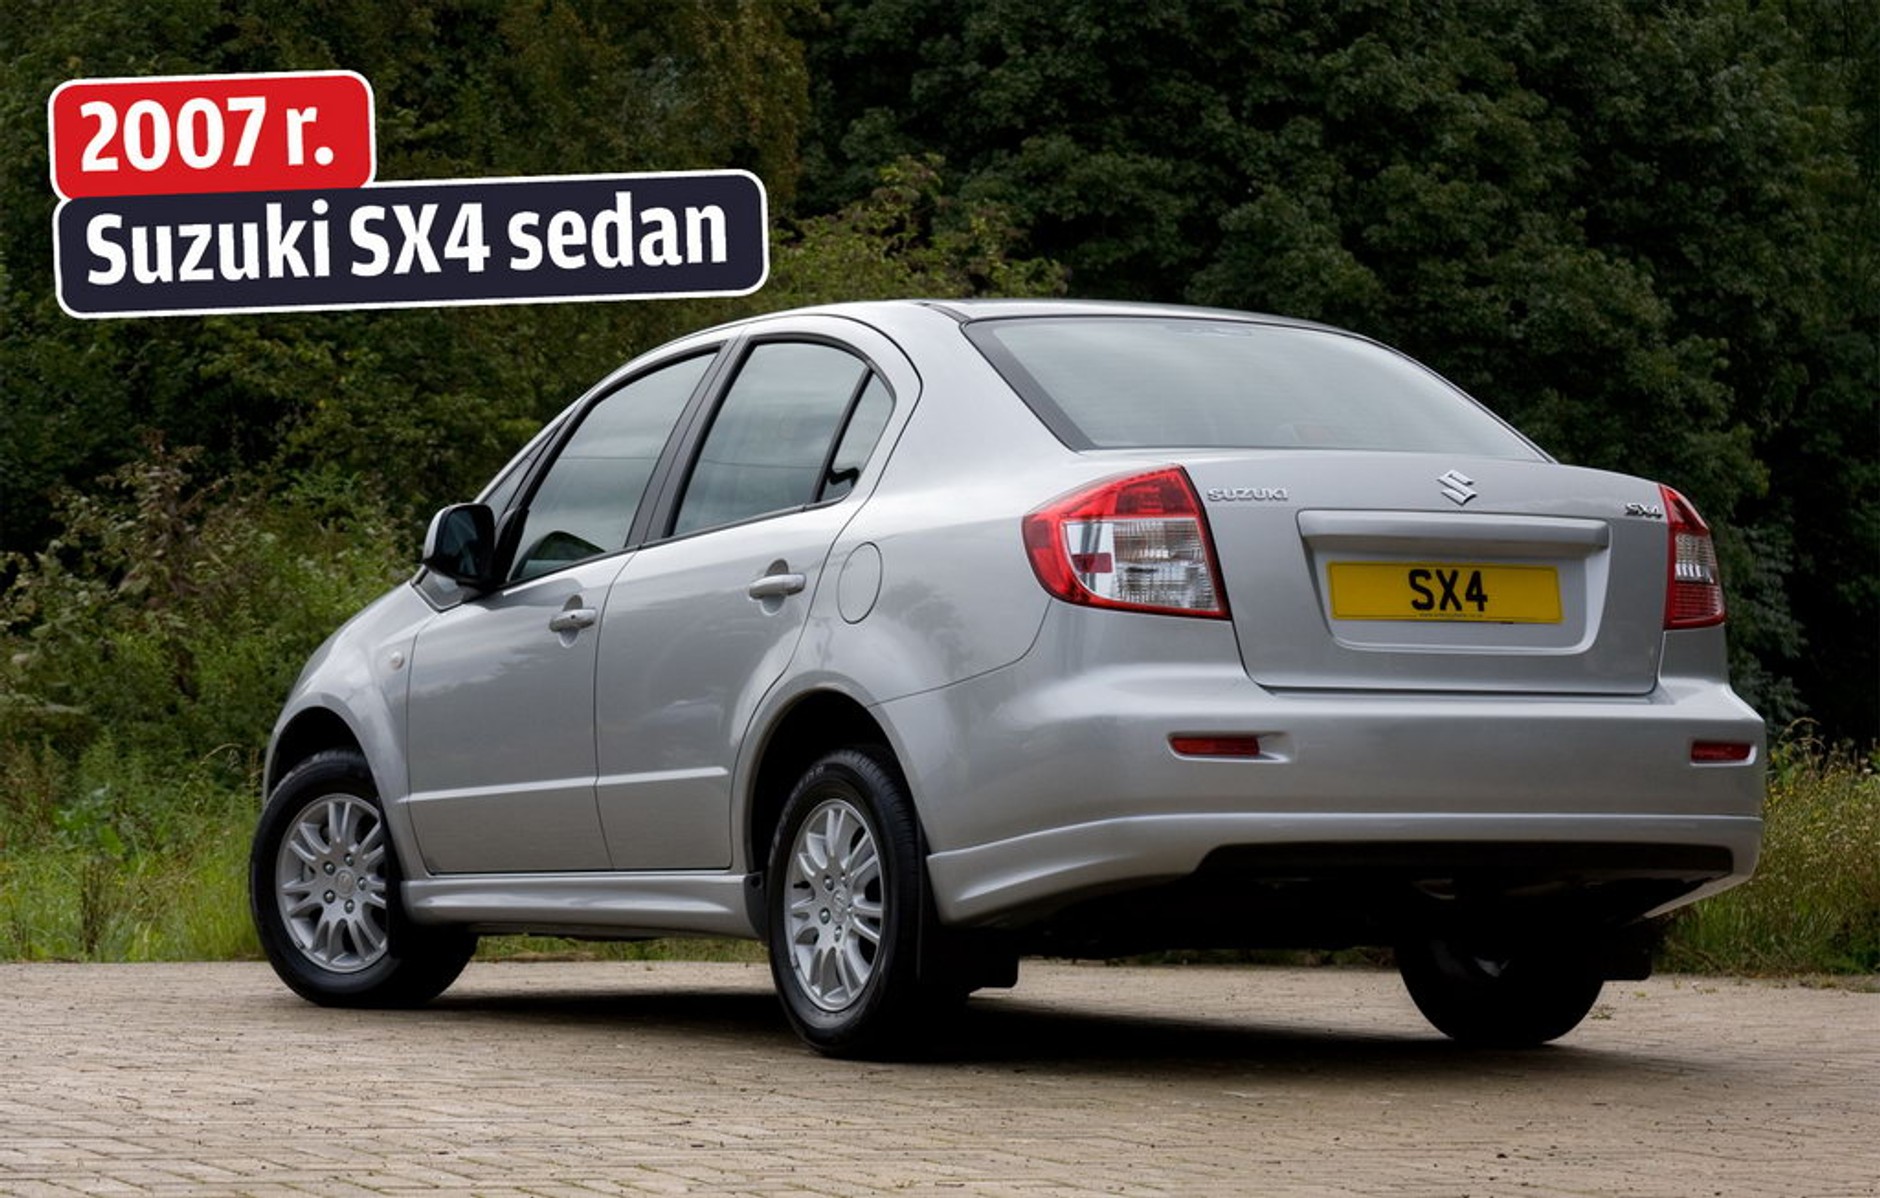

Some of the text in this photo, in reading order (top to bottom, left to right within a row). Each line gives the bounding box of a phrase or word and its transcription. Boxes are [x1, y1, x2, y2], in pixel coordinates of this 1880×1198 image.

[1207, 488, 1288, 502] SUZUKI
[1625, 502, 1662, 519] SX4
[1408, 568, 1488, 612] SX4
